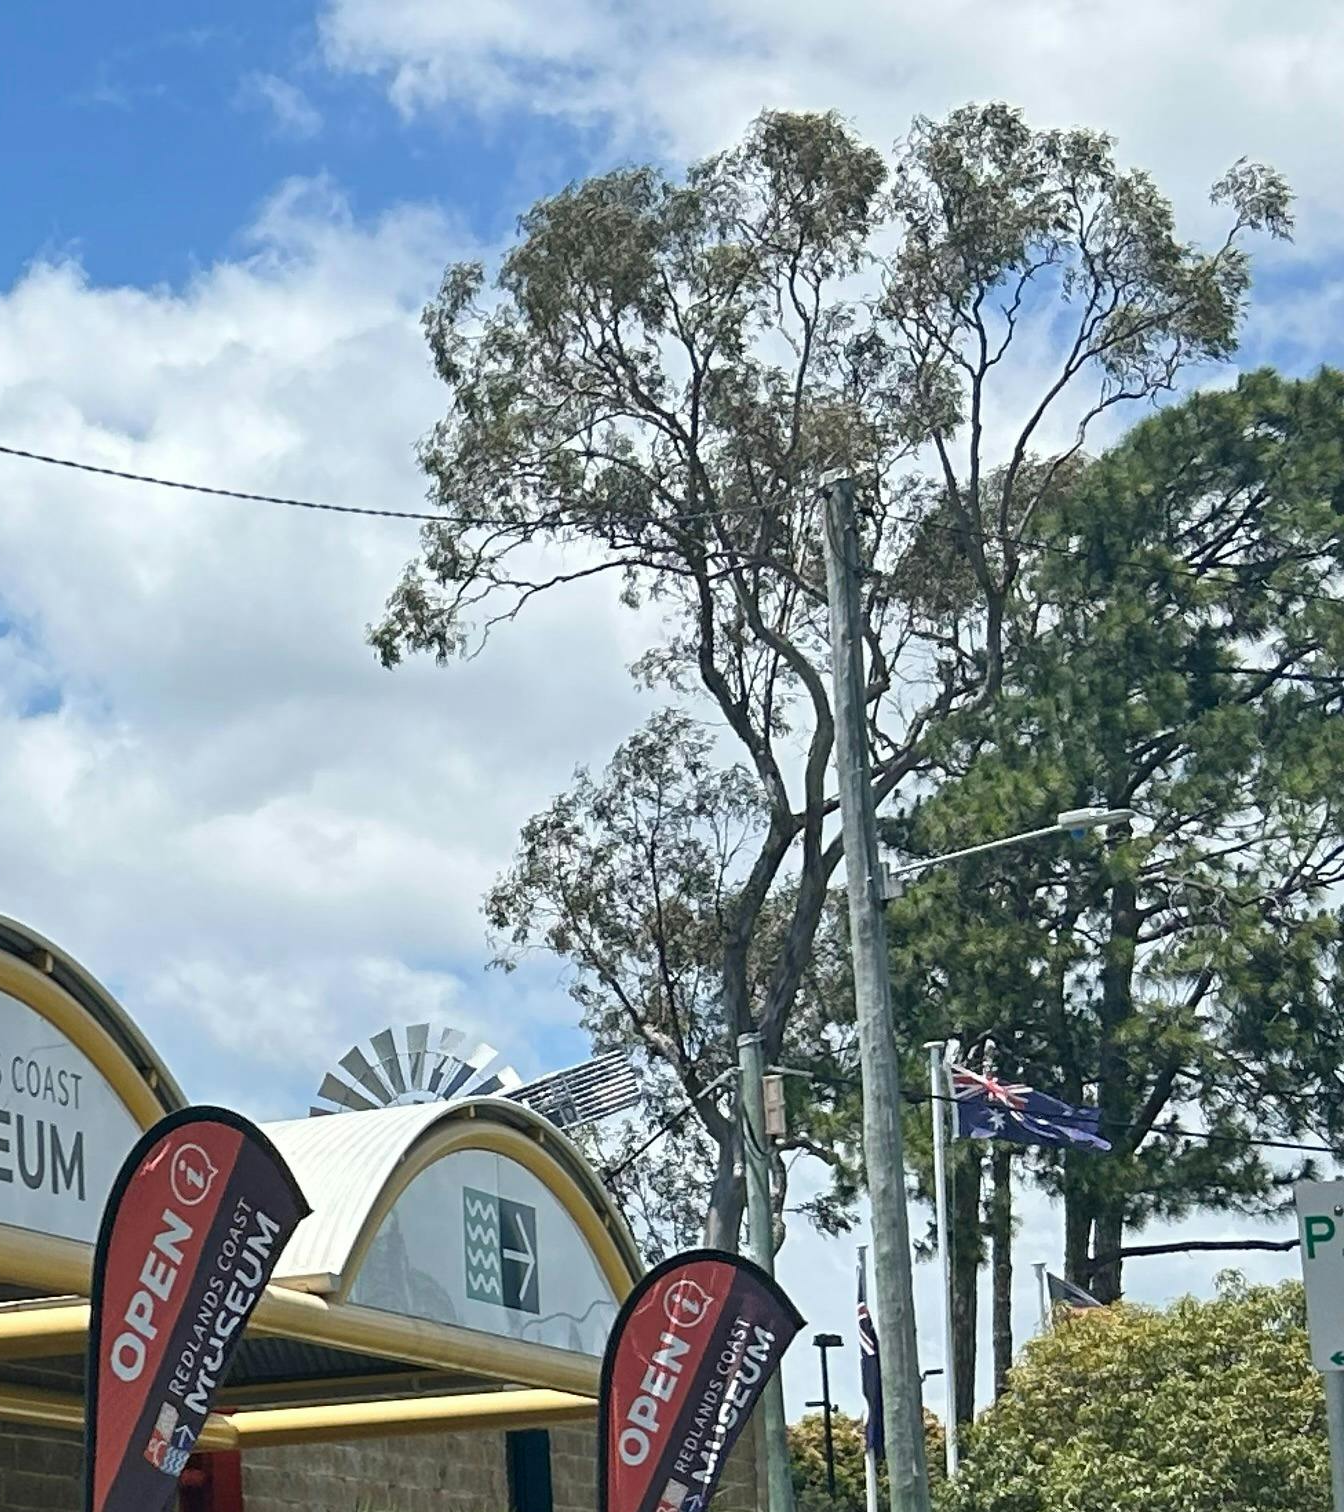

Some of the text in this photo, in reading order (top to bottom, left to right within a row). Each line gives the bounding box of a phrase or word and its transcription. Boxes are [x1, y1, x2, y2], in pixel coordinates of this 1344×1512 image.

[12, 1056, 82, 1109] COAST
[110, 1208, 194, 1383] OPEN
[168, 1197, 253, 1397] REDLANDS COAST
[1304, 1216, 1335, 1260] P
[618, 1331, 691, 1467] OPEN
[673, 1315, 752, 1474] REDLANDS COAST
